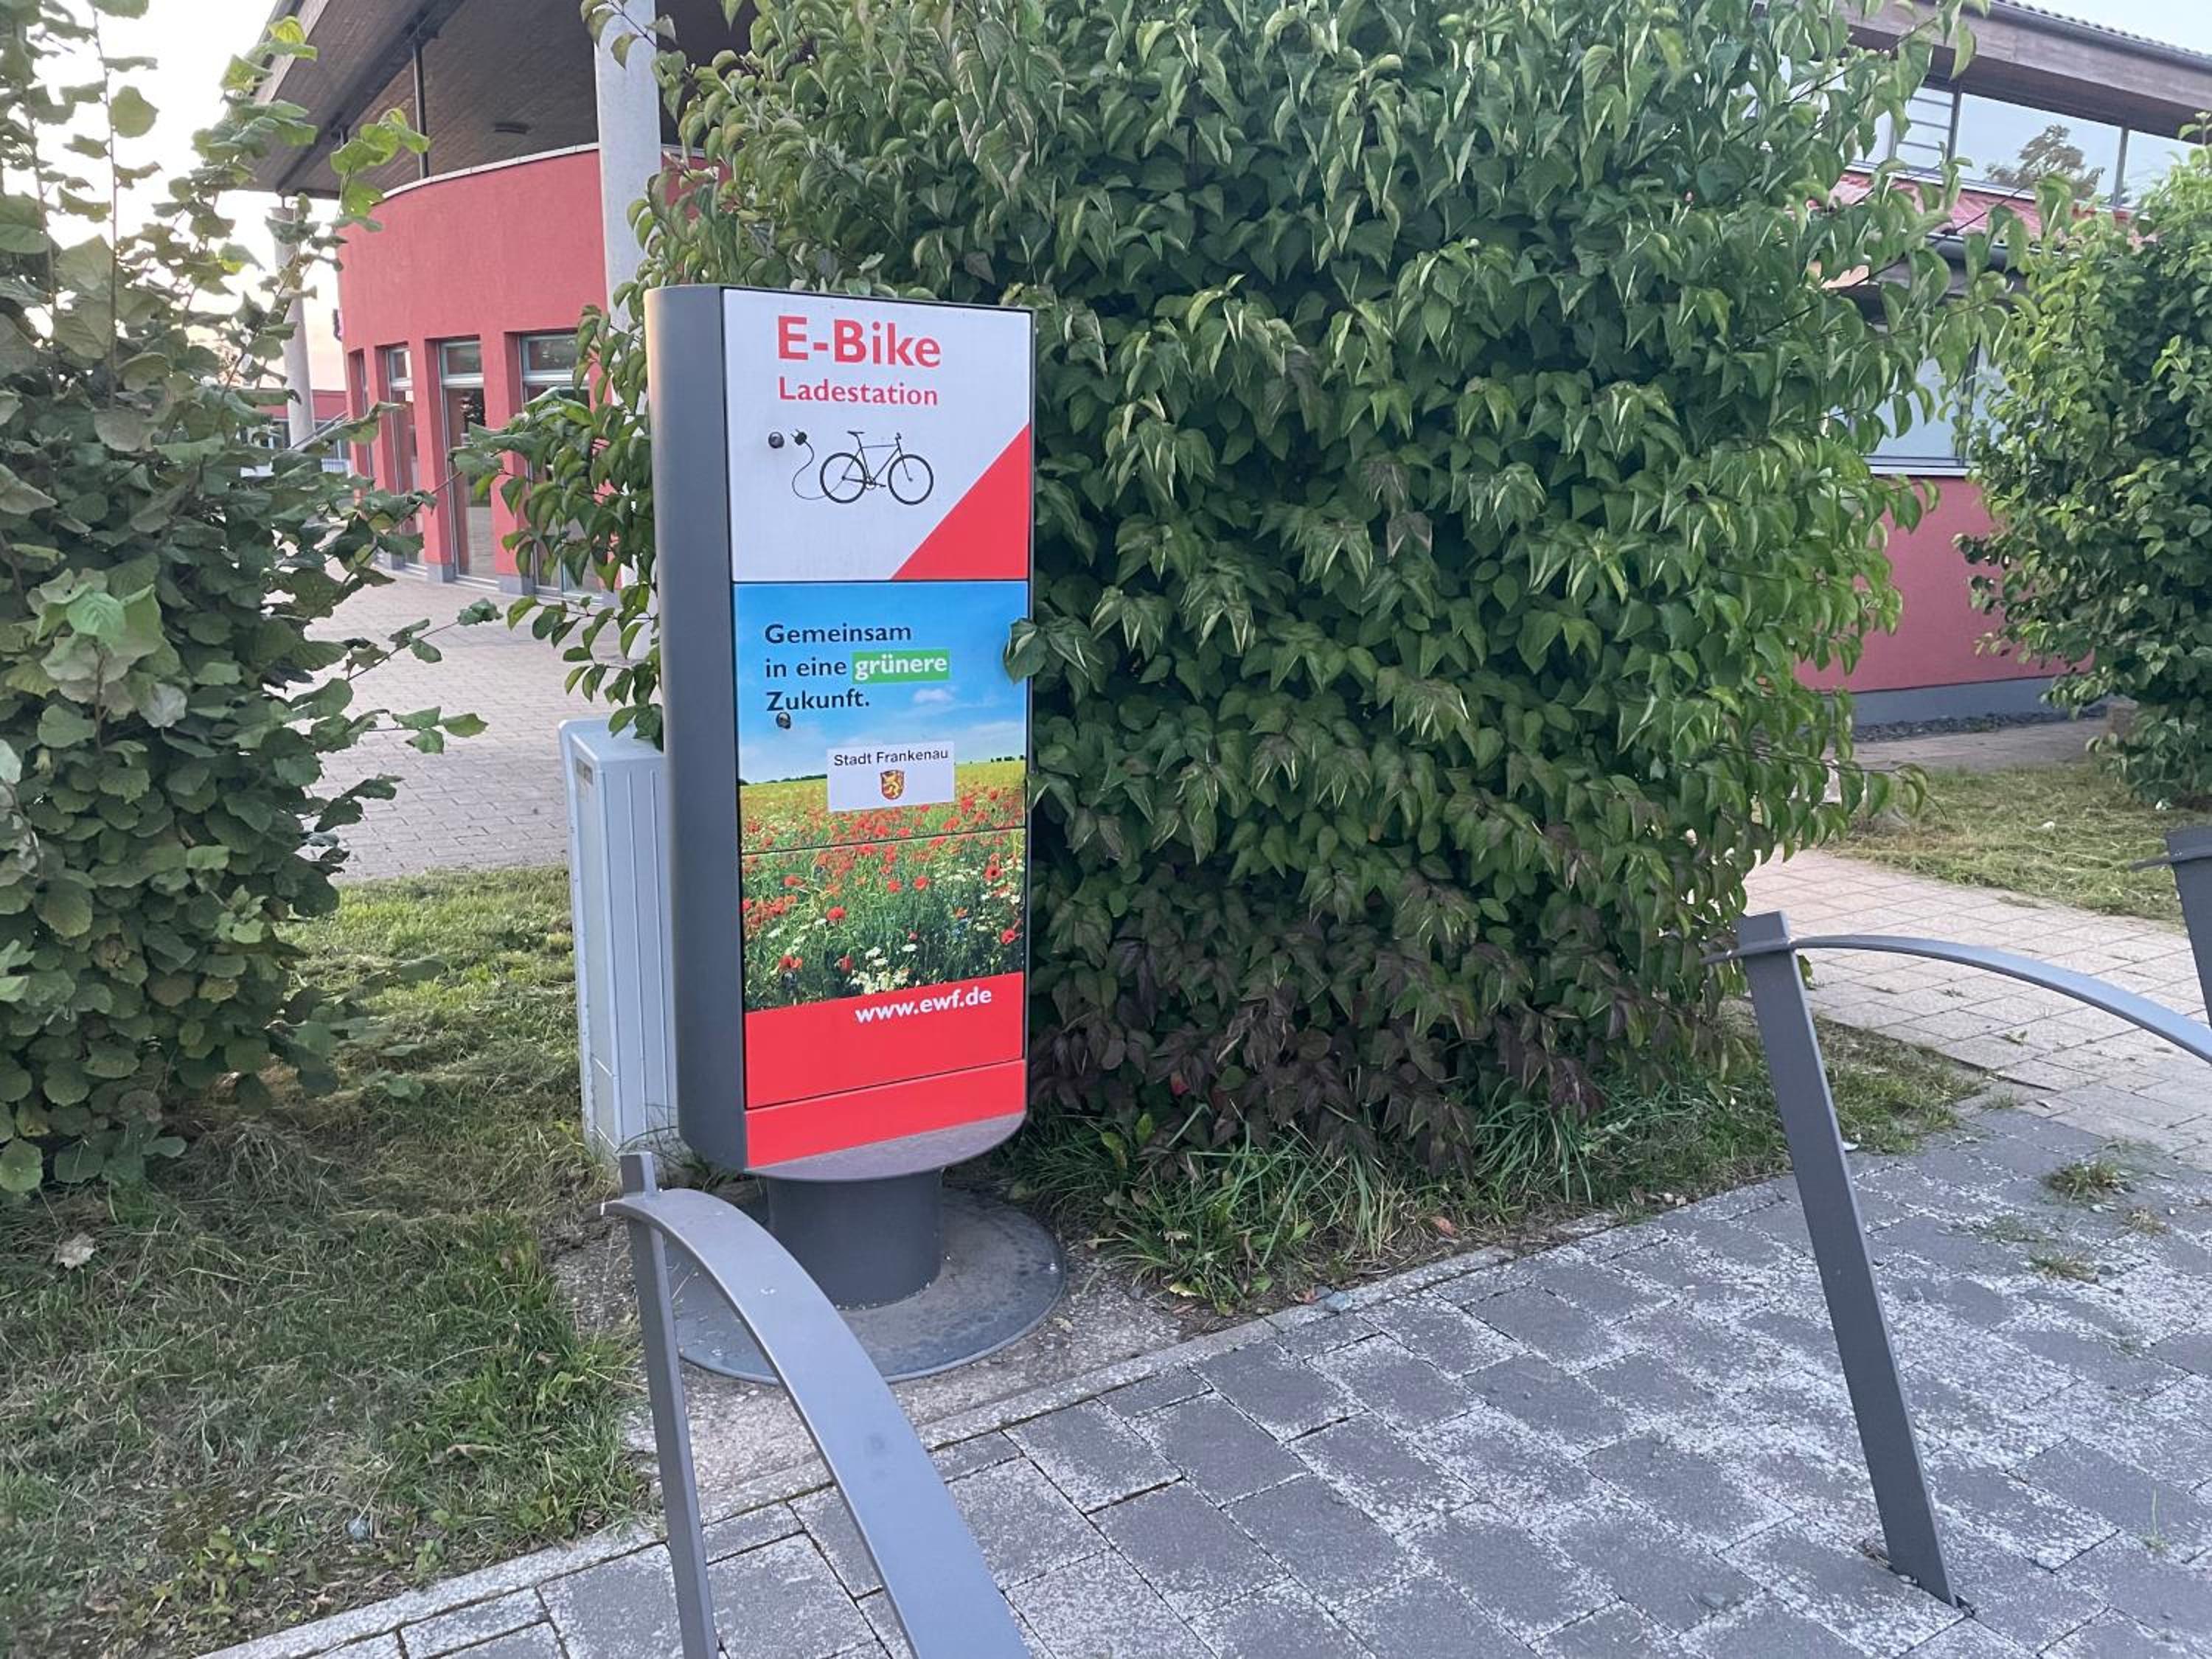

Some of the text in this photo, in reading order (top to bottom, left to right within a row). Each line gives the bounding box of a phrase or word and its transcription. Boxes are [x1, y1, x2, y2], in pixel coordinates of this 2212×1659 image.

[777, 315, 941, 368] E-Bike
[779, 376, 938, 406] Ladestation
[765, 623, 911, 644] Gemeinsam
[765, 653, 947, 681] in eine grünere
[766, 688, 870, 712] Zukunft.
[834, 750, 949, 766] Stadt Frankenau
[855, 986, 992, 1024] www.ewf.de
